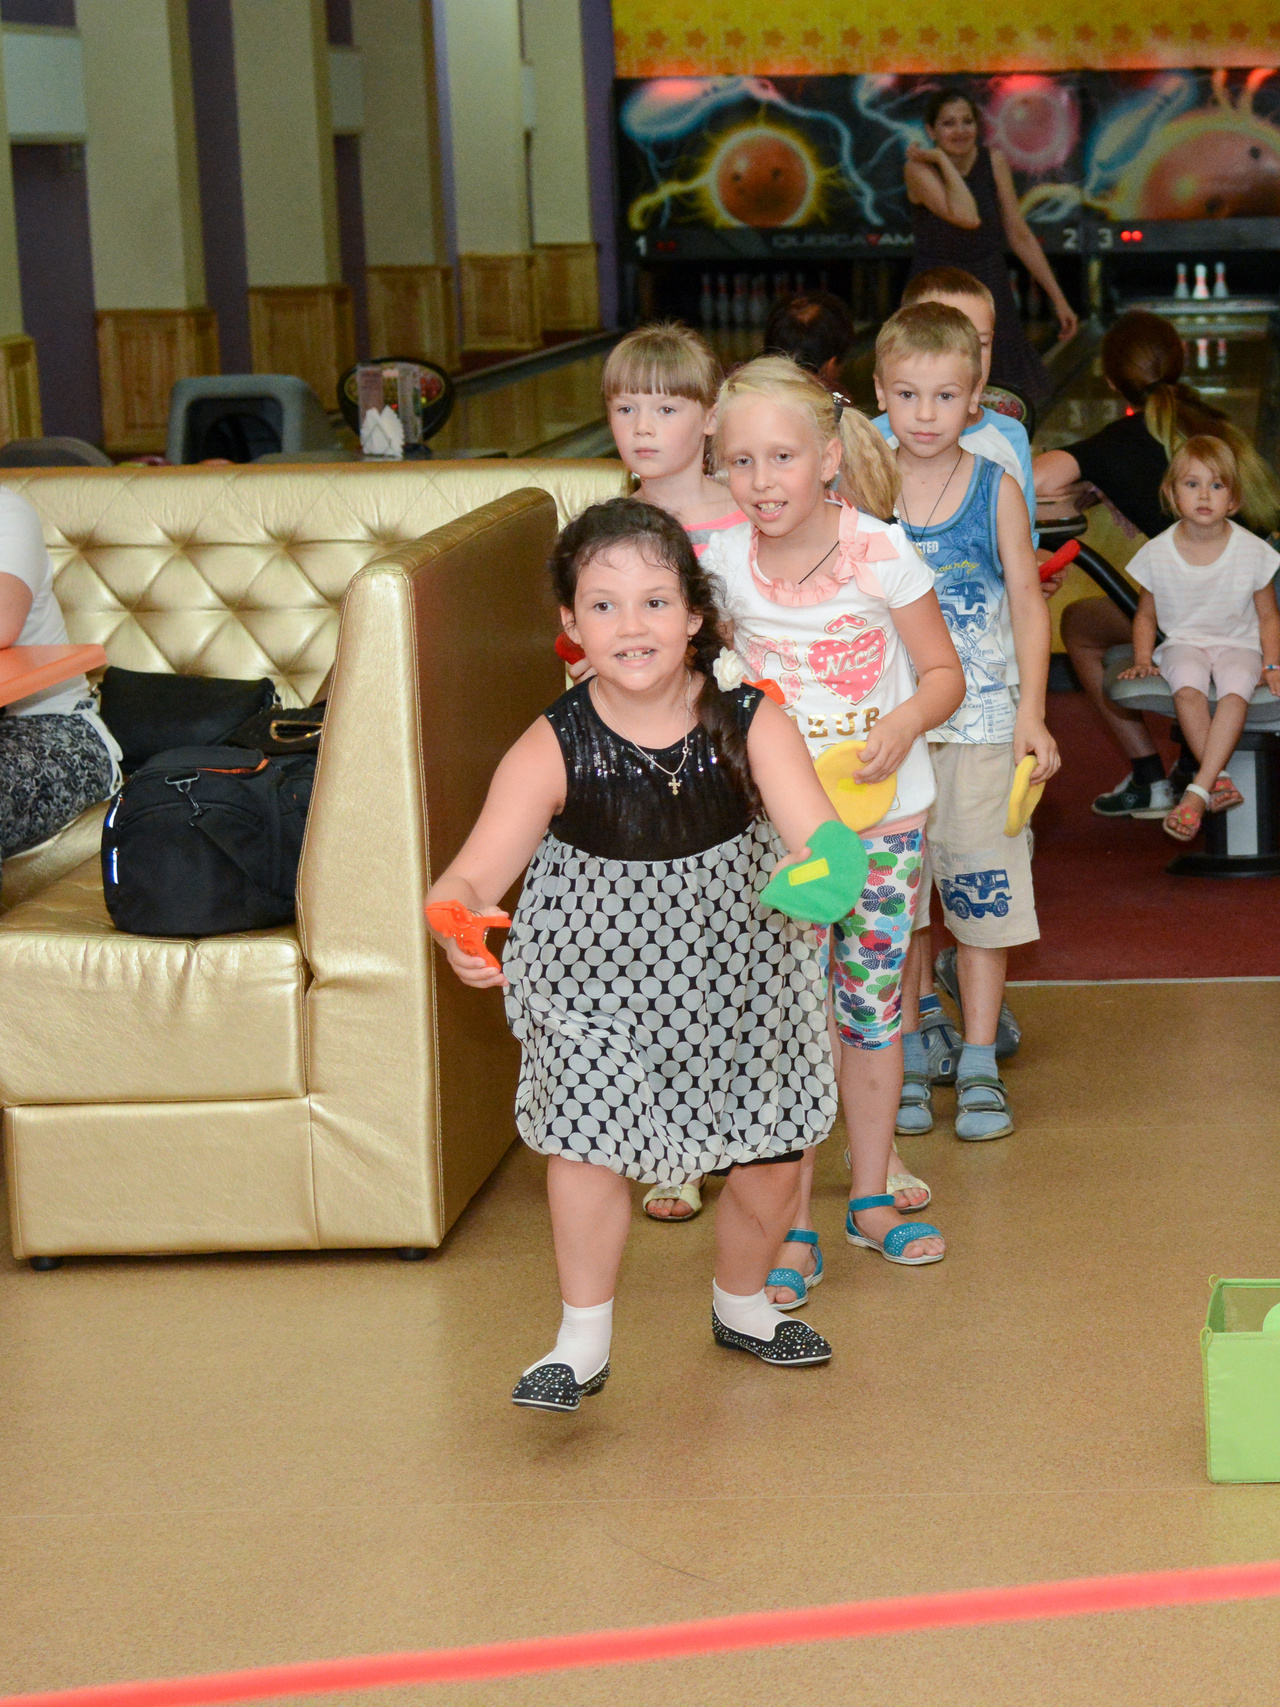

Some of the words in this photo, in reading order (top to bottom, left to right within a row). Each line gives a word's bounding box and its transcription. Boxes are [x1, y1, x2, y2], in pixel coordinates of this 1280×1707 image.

[635, 235, 648, 256] 1
[1062, 228, 1078, 250] 2
[1098, 228, 1114, 250] 3
